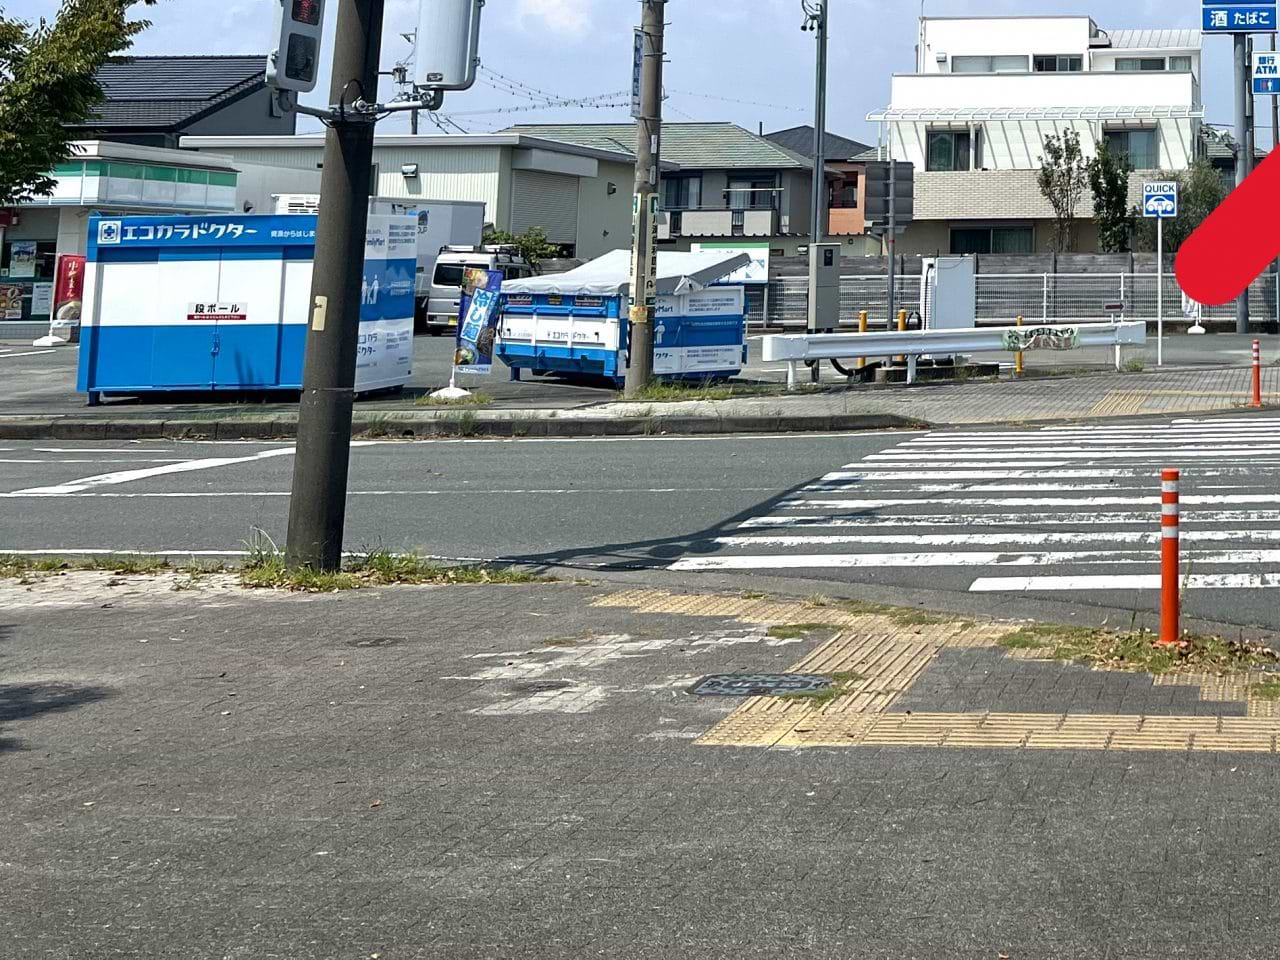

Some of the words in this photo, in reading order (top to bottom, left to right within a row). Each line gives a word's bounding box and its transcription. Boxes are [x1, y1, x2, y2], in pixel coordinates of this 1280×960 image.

[1210, 10, 1228, 27] 酒
[1234, 12, 1270, 25] たばこ
[1255, 66, 1278, 74] ATM
[1144, 184, 1175, 193] QUICK
[122, 223, 258, 240] エコカラドクター
[194, 304, 240, 314] 段ボール
